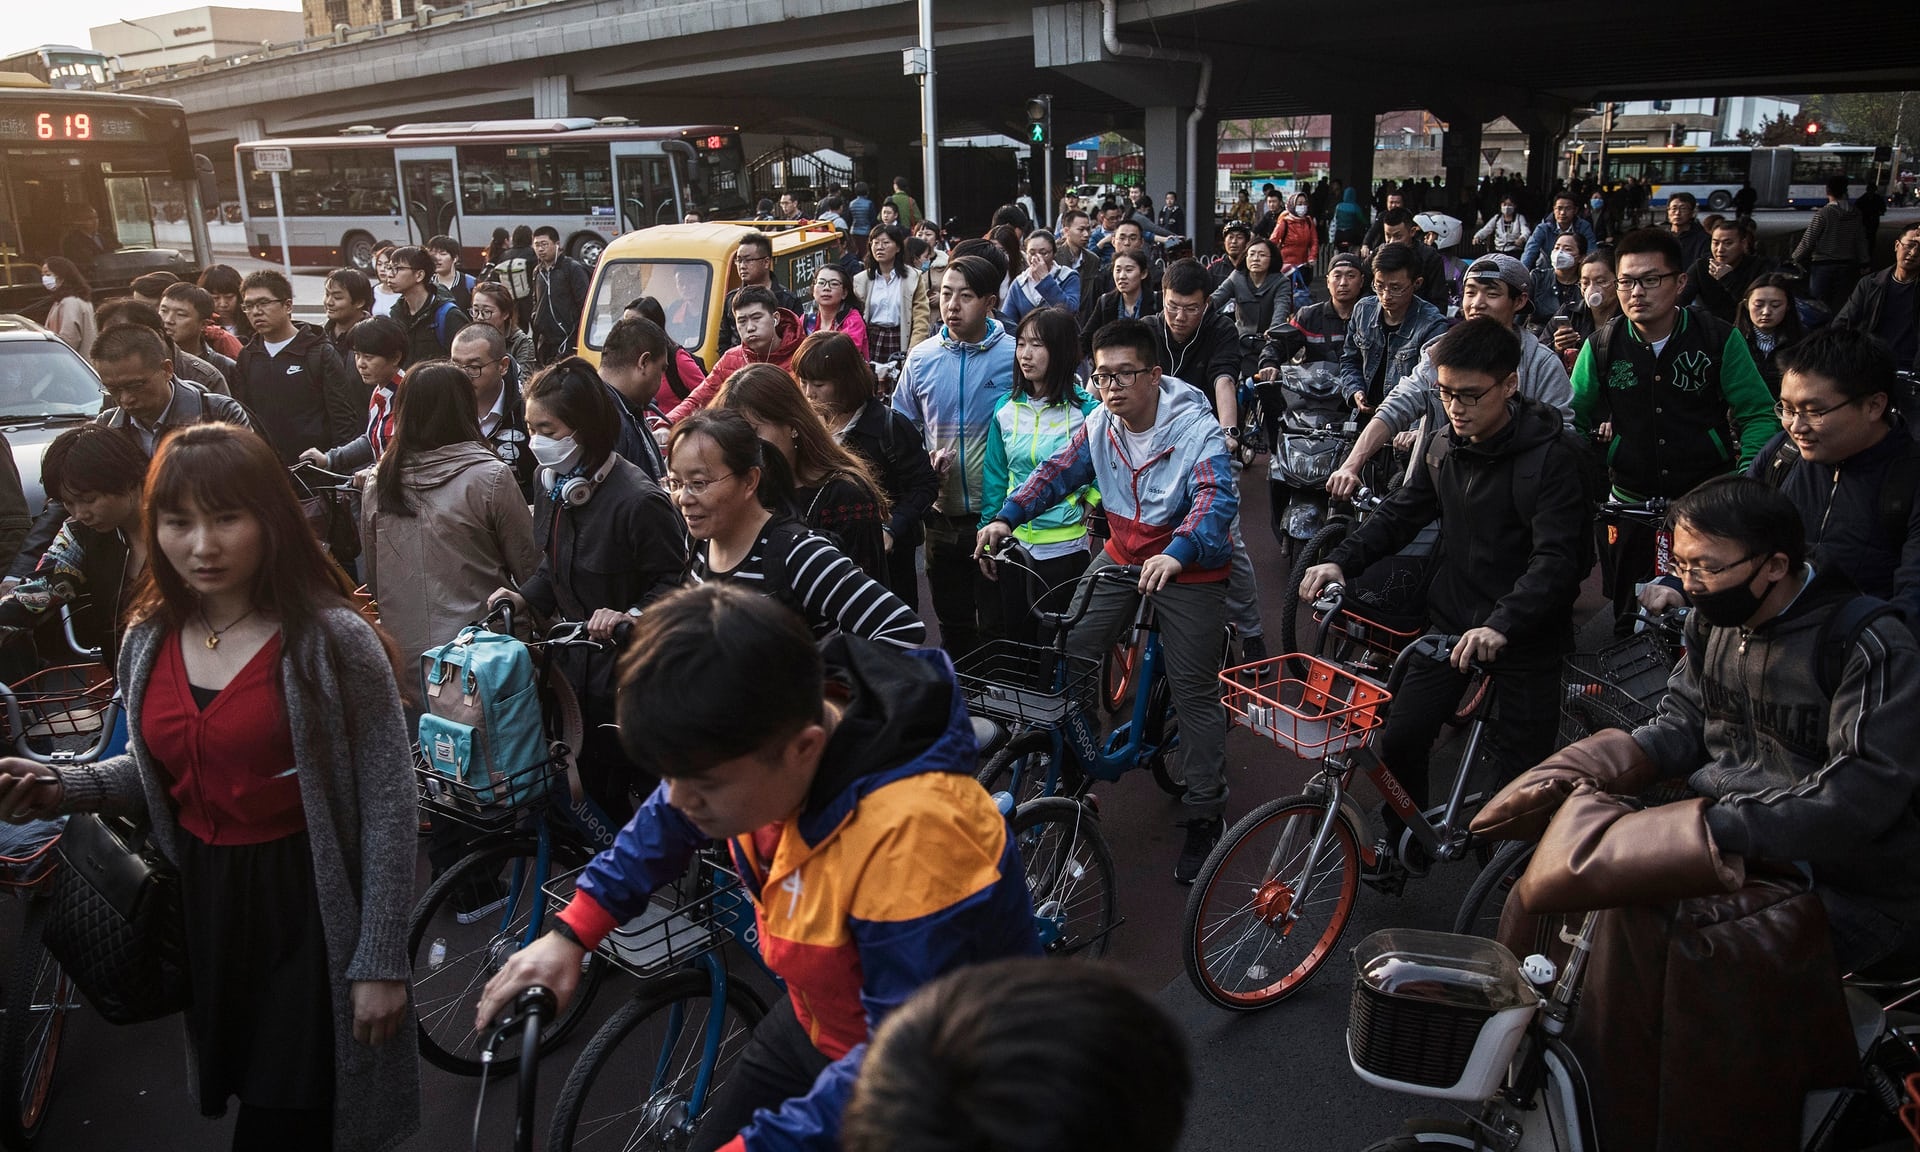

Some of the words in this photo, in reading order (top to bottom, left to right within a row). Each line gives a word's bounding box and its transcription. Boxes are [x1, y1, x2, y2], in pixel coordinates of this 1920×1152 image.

[38, 113, 90, 138] 619
[1672, 350, 1712, 392] NY
[1379, 770, 1410, 809] mobike
[570, 800, 616, 848] luego
